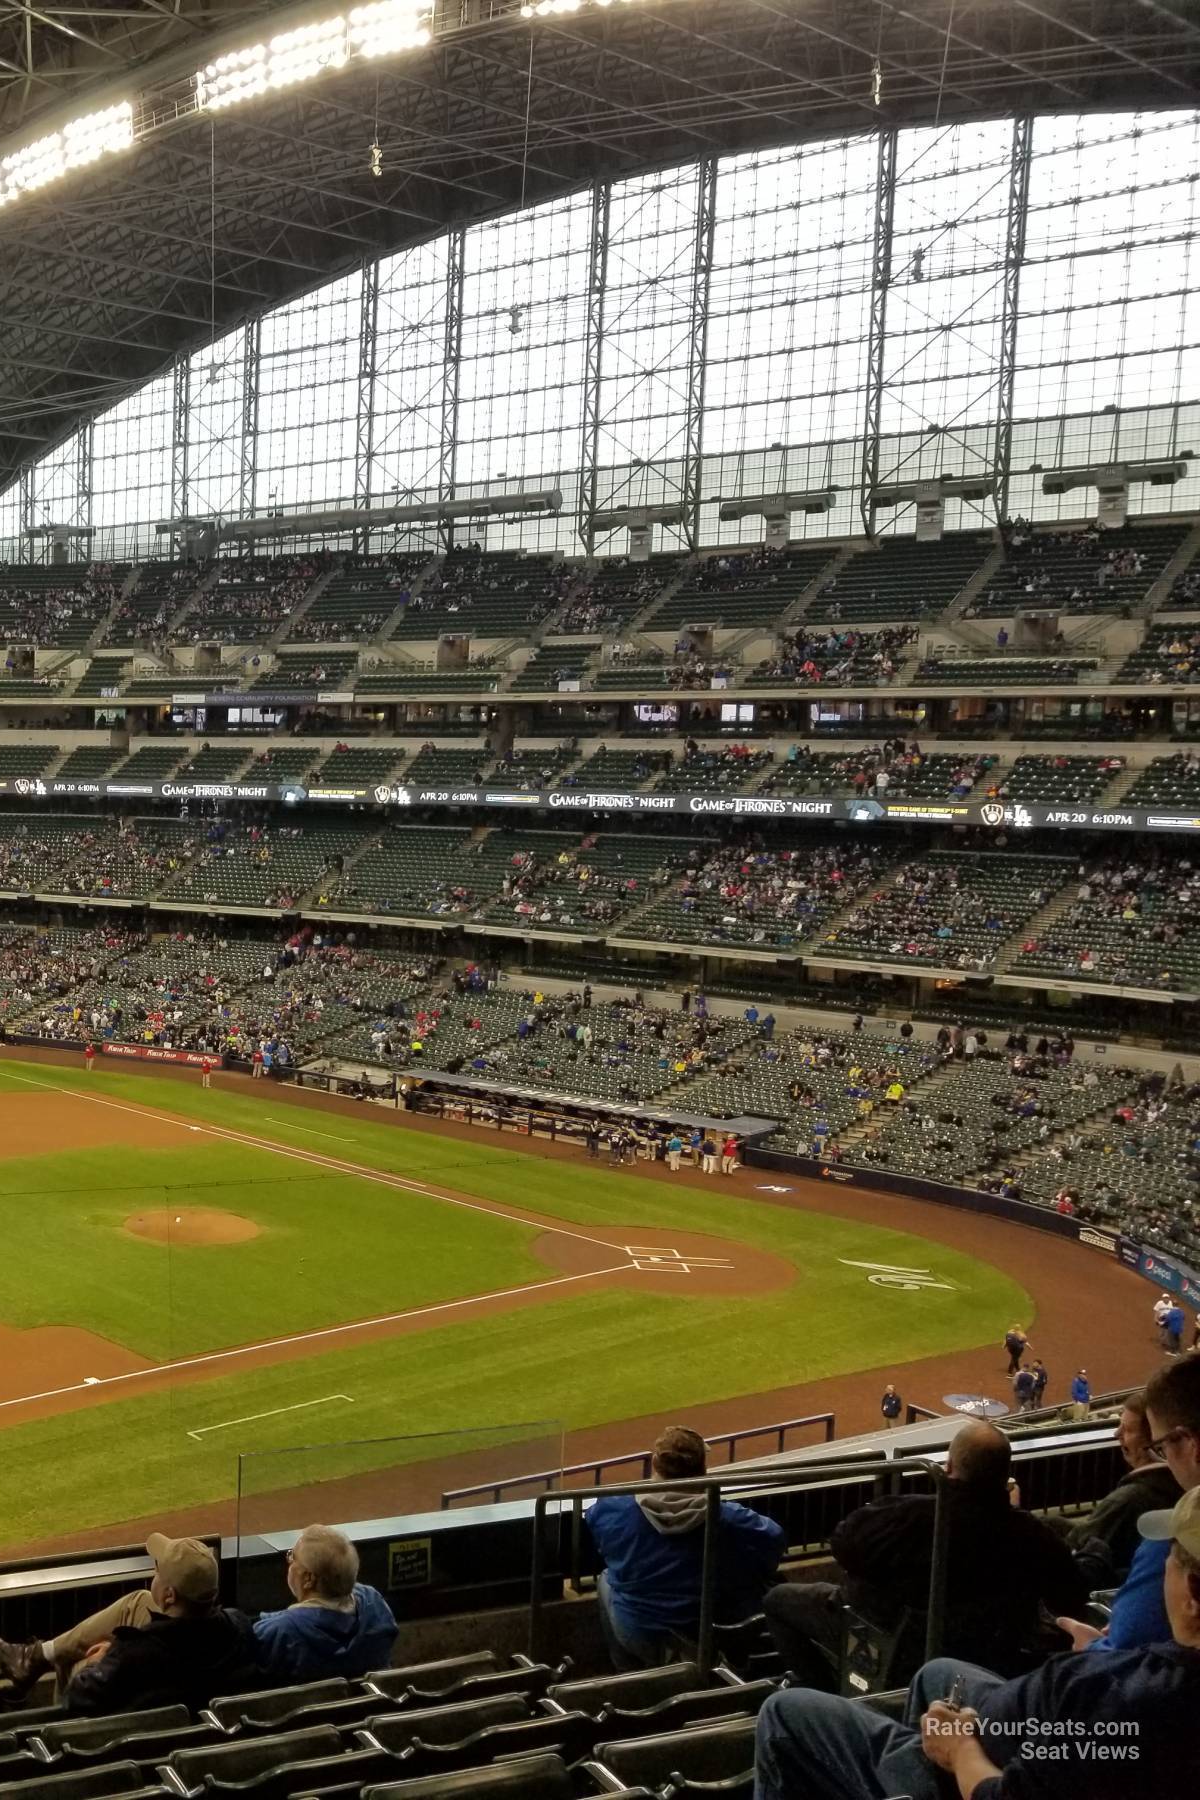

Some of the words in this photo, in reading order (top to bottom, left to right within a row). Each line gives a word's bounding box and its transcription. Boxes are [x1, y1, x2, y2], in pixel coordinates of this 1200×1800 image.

[77, 784, 99, 792] 6:10PM
[161, 784, 188, 796] GAME
[193, 784, 233, 797] THRONES
[237, 787, 268, 797] NIGHT
[419, 792, 437, 801] APR
[437, 792, 448, 801] 20
[451, 792, 478, 802] 6:10PM
[549, 793, 581, 806] GAME
[586, 794, 634, 808] THRONES
[640, 797, 676, 808] NIGHT
[690, 797, 726, 812] GAME
[732, 798, 786, 813] THRONES
[792, 802, 833, 814] NIGHT
[1045, 812, 1071, 822] APR
[1071, 813, 1087, 823] 20
[1092, 814, 1133, 825] 6:10PM
[107, 1044, 124, 1053] KWIK
[124, 1046, 137, 1054] TRIP
[146, 1049, 163, 1057] KWIK
